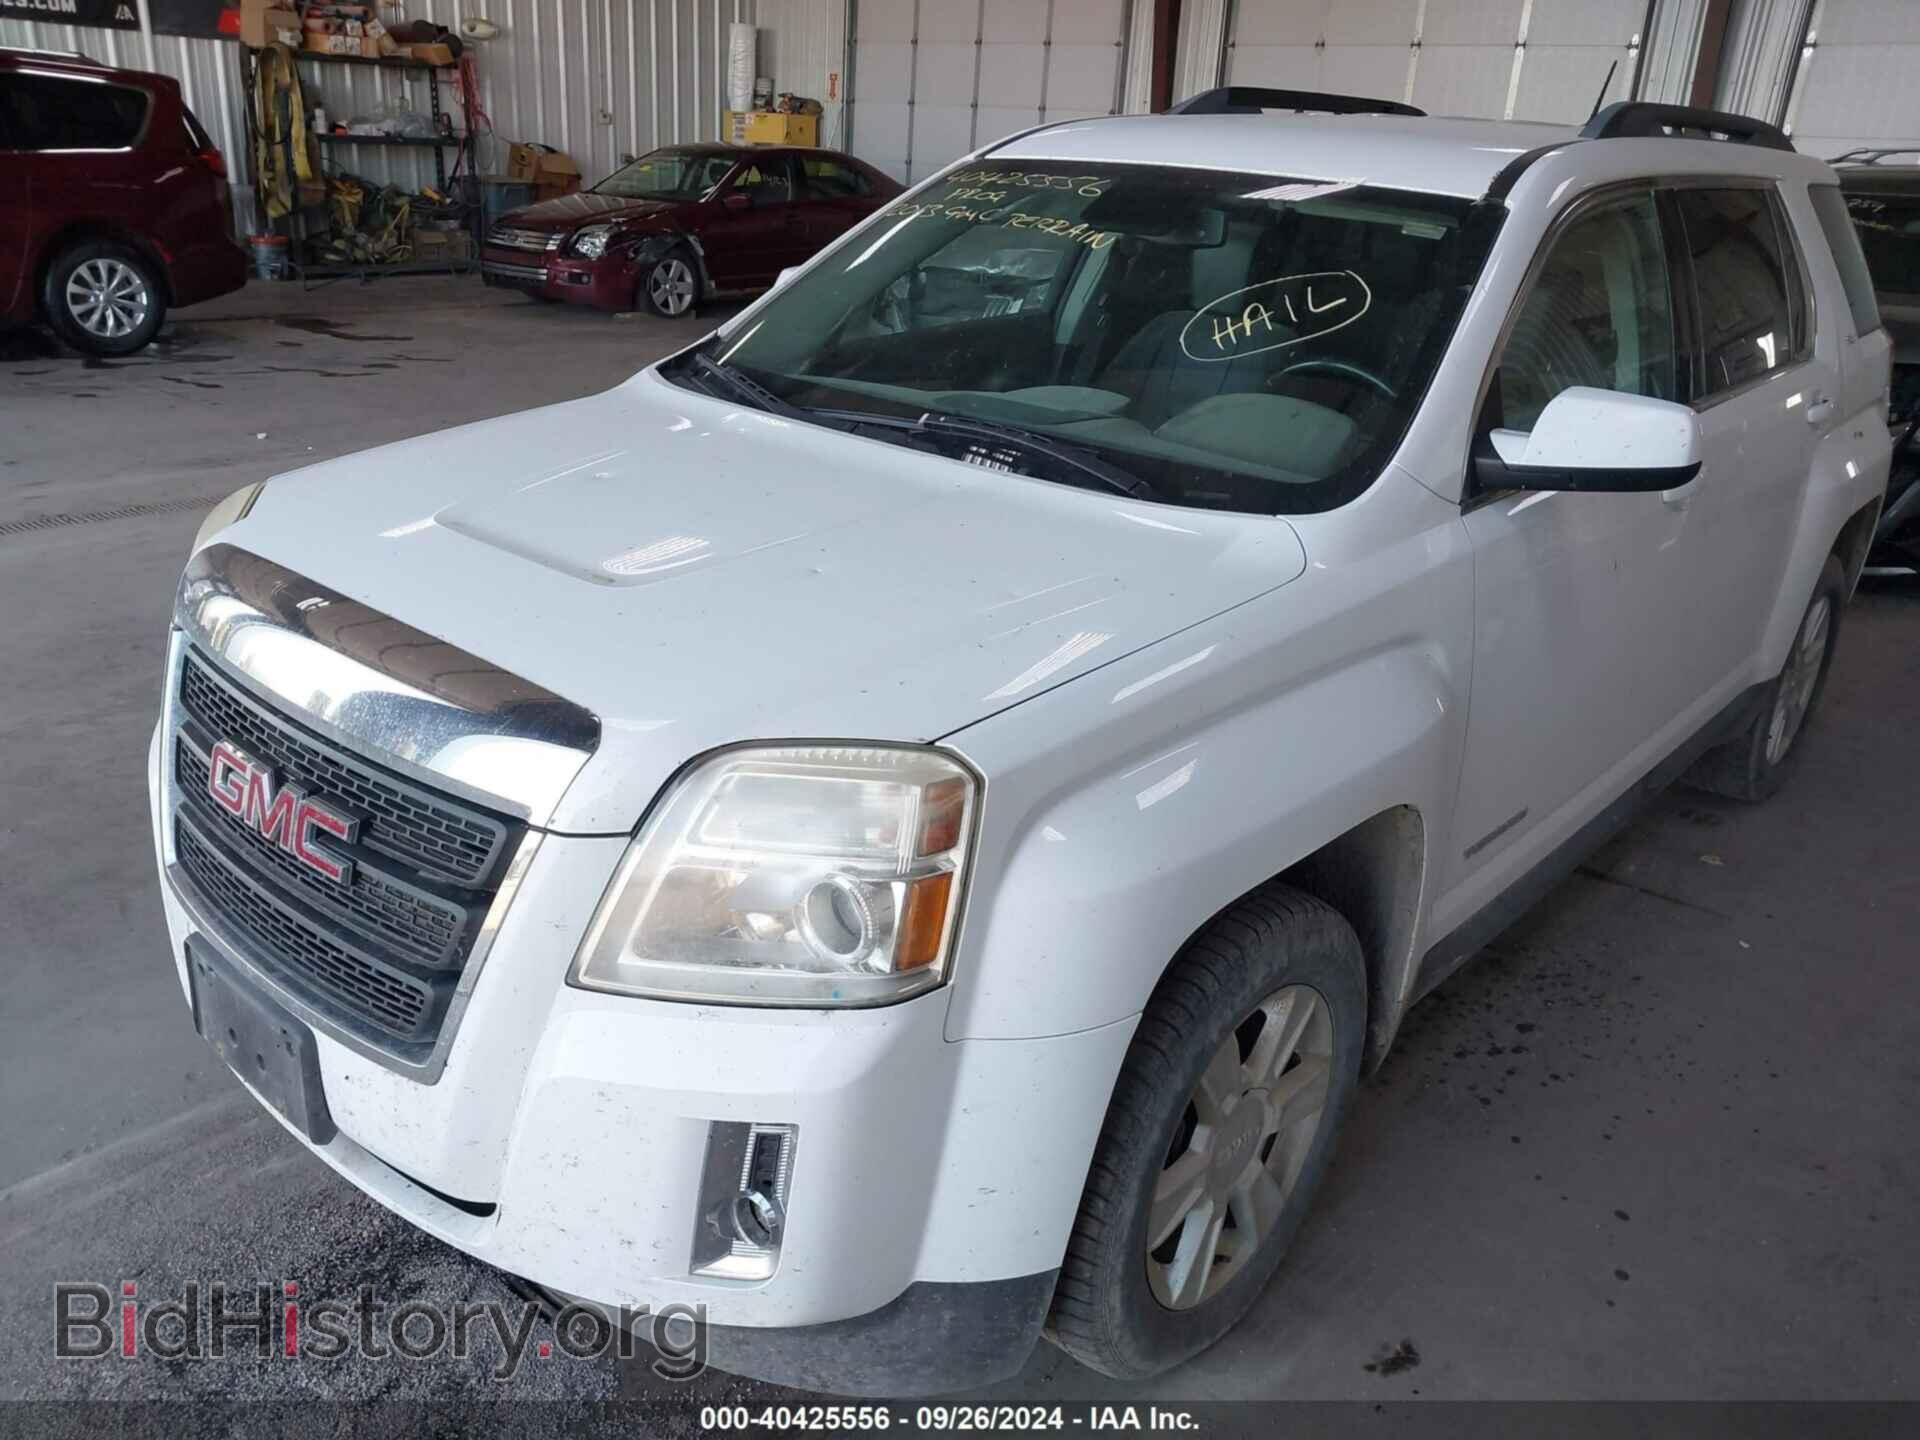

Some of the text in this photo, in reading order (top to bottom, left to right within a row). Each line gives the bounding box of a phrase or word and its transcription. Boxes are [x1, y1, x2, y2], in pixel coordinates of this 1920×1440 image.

[945, 168, 1112, 198] 40425556
[1211, 286, 1347, 350] HAIL
[208, 739, 360, 886] GMC
